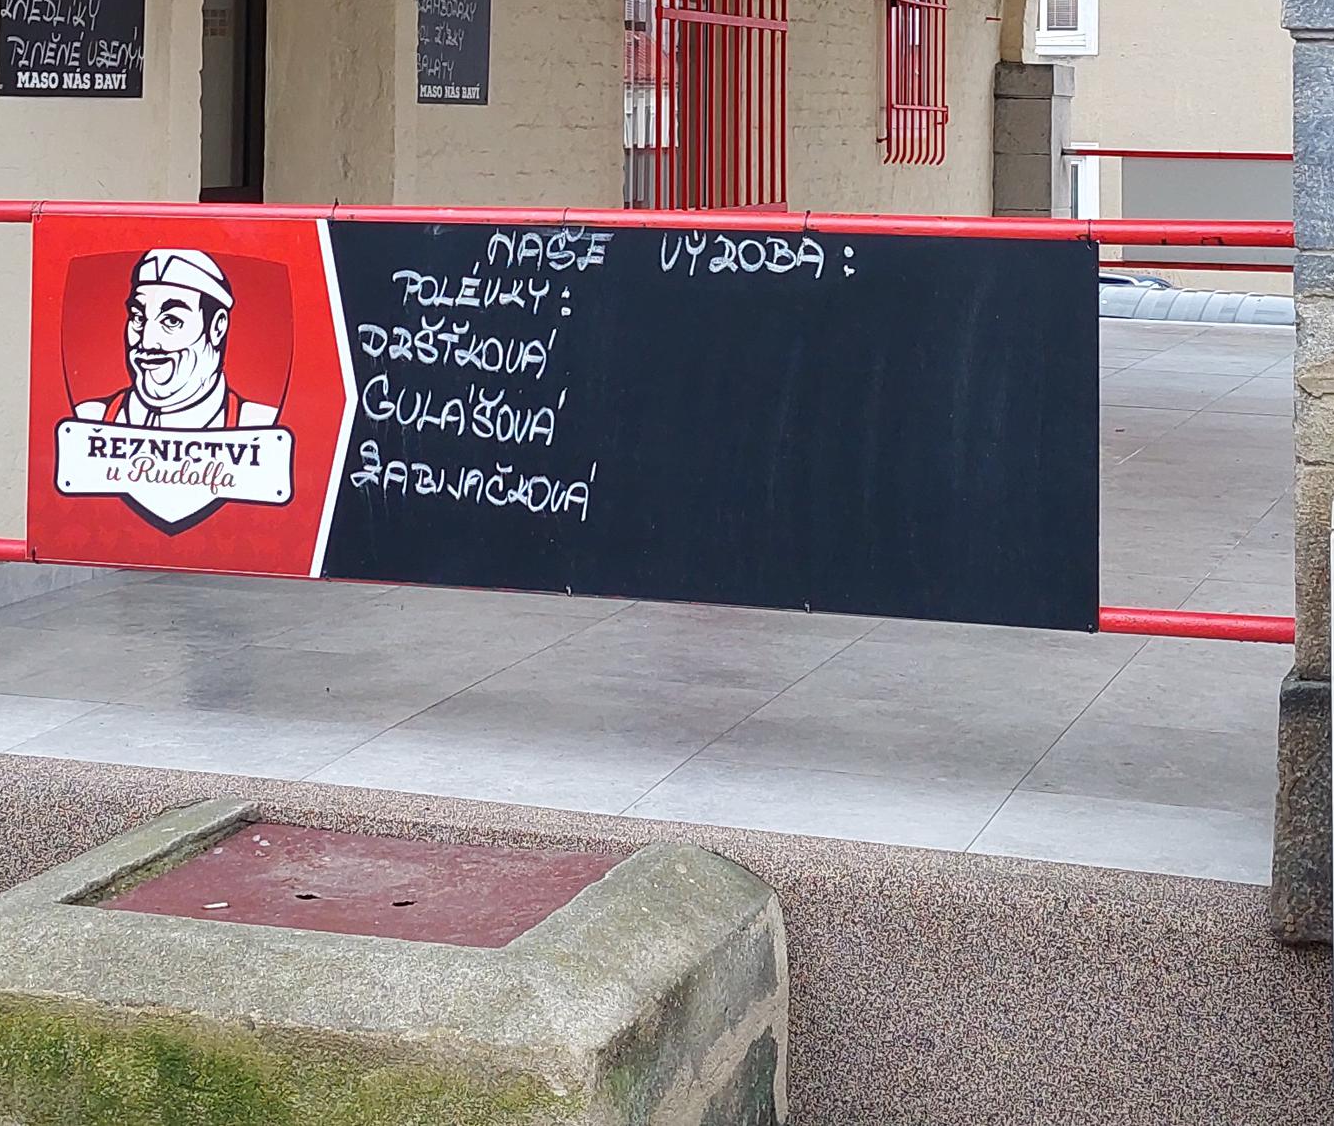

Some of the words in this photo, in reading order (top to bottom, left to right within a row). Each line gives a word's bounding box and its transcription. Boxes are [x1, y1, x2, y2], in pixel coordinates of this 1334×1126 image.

[7, 31, 85, 69] PLNĚNÉ
[17, 71, 59, 89] MASO
[62, 68, 92, 90] NÁS
[94, 68, 128, 91] BAVÍ
[420, 84, 443, 99] MASO
[444, 81, 461, 99] NÁS
[461, 82, 481, 100] BAVÍ
[486, 225, 615, 271] NAŠE
[357, 314, 557, 380] DRŠŤKOVÁ
[361, 373, 568, 447] GULÁŠOVÁ
[87, 427, 262, 467] ŘEZNICTVÍ
[105, 465, 122, 482] u
[127, 455, 237, 495] Rudolfa
